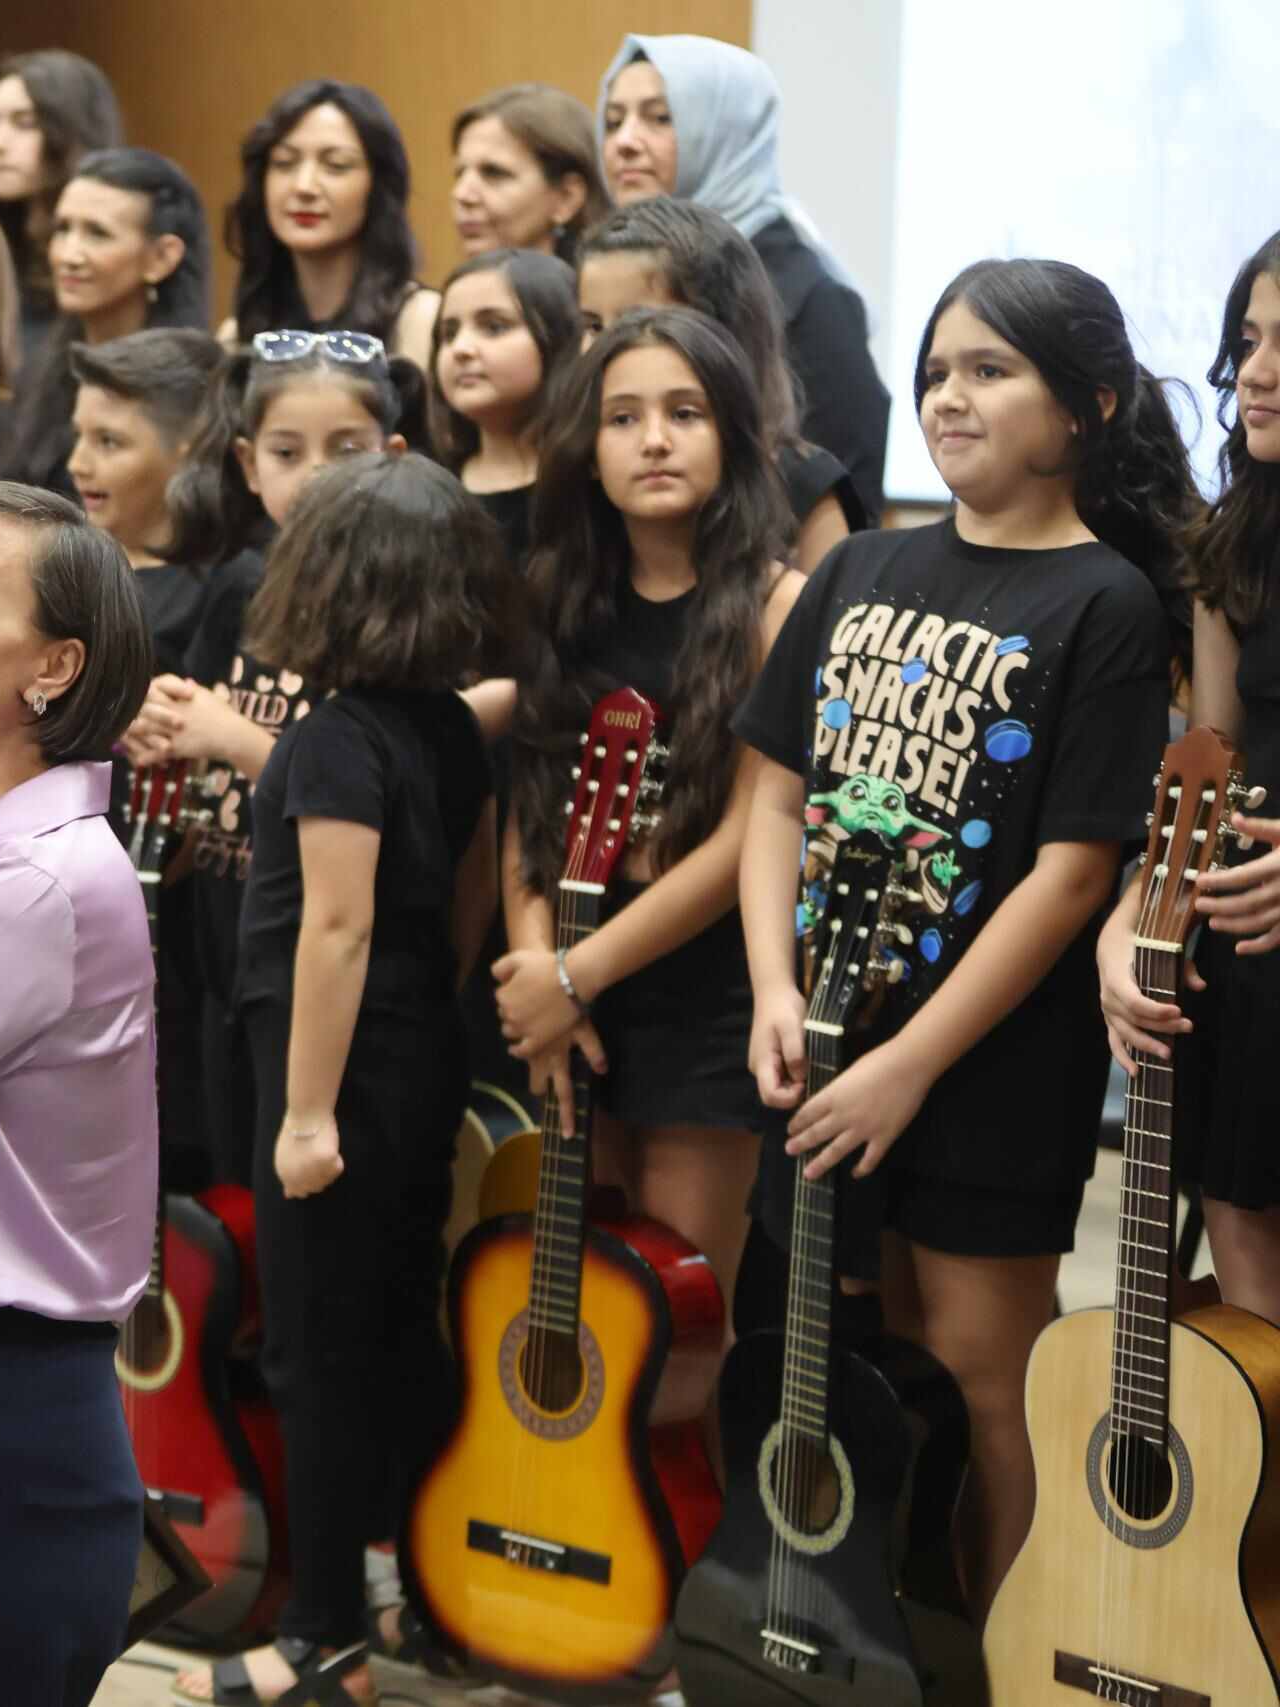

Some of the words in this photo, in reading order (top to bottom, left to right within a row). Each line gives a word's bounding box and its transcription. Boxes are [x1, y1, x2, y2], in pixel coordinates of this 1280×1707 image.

[817, 655, 982, 750] SNACKS
[830, 603, 1030, 712] GALACTIC
[813, 714, 977, 817] PLEASE!
